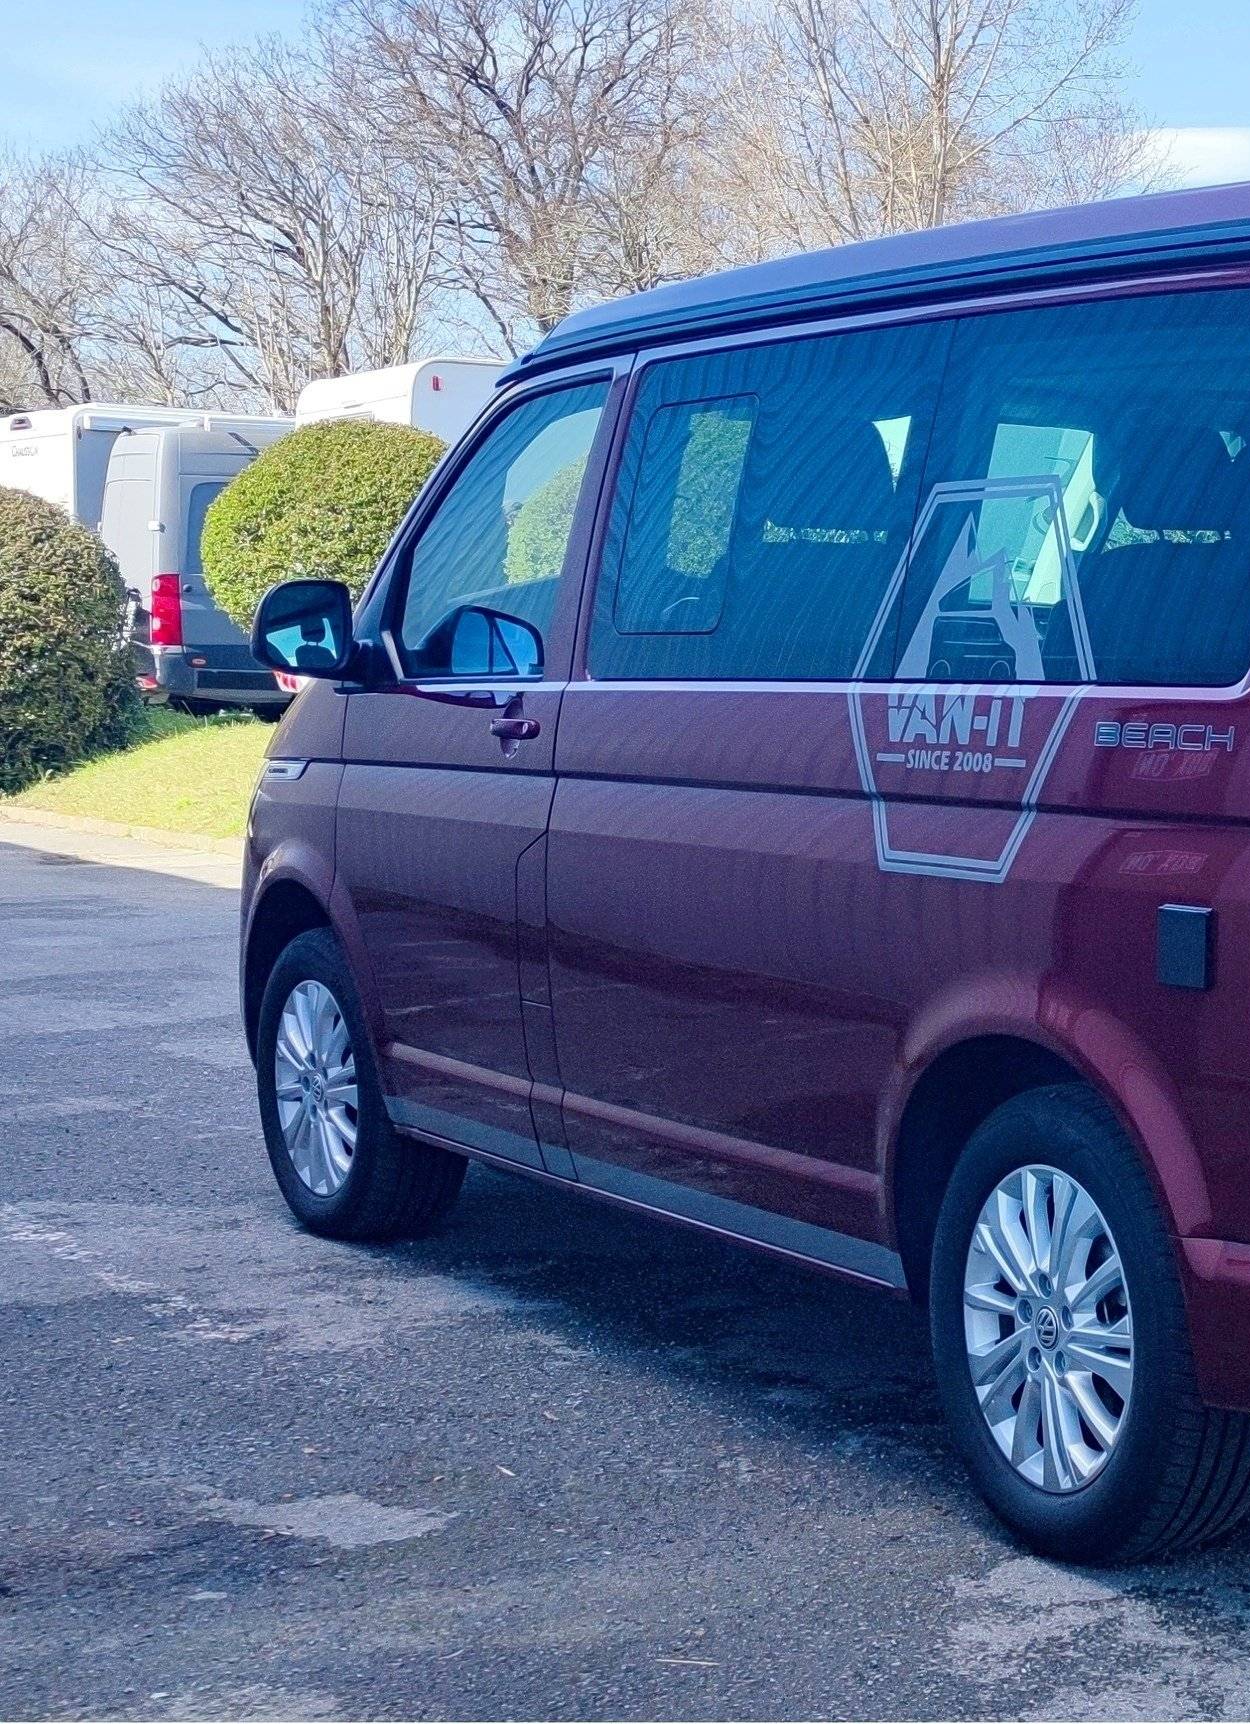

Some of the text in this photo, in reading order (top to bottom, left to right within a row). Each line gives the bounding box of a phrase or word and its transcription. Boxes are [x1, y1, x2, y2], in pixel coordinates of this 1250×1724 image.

[1094, 721, 1235, 751] BEACH
[906, 750, 992, 773] SINCE 2008
